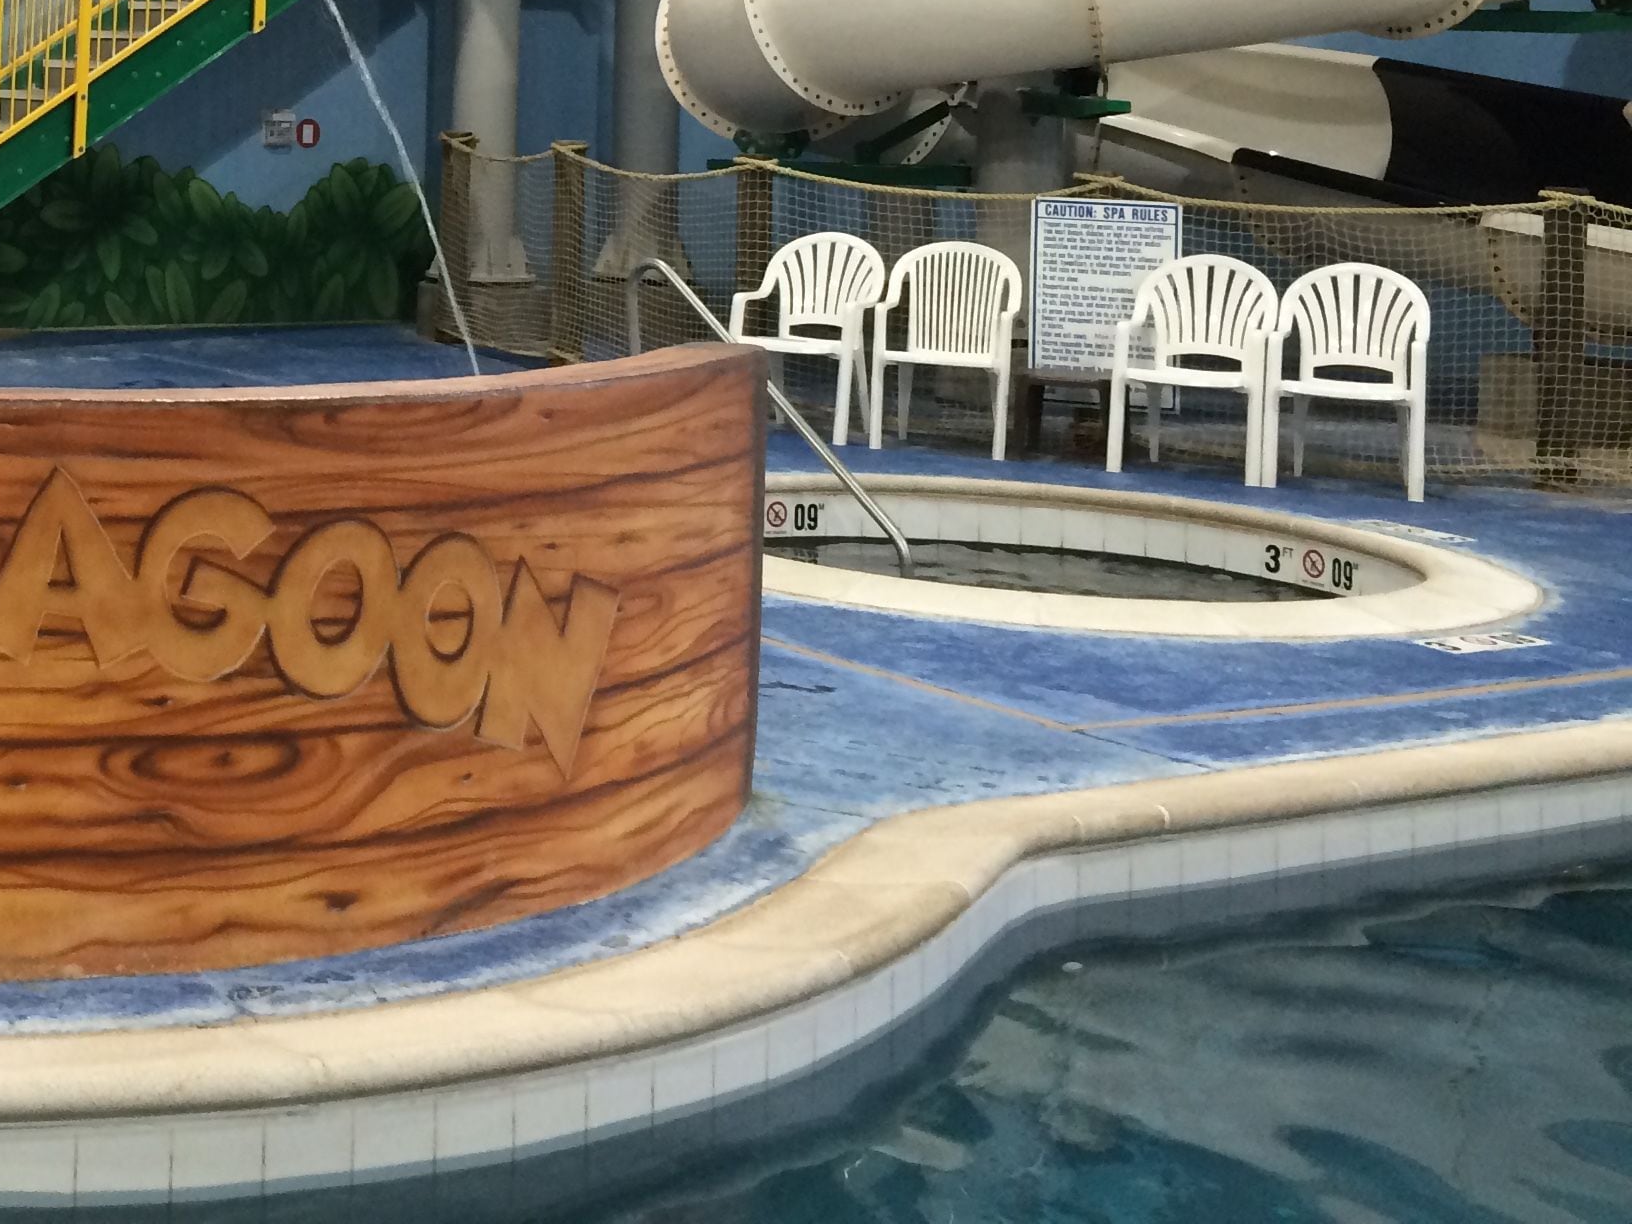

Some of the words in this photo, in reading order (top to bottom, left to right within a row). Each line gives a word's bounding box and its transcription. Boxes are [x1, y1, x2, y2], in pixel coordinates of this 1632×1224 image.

[1045, 204, 1097, 218] CAUTION:
[1103, 207, 1125, 220] SPA
[1132, 209, 1168, 222] RULES
[1265, 545, 1280, 573] 3
[1283, 547, 1294, 558] FT
